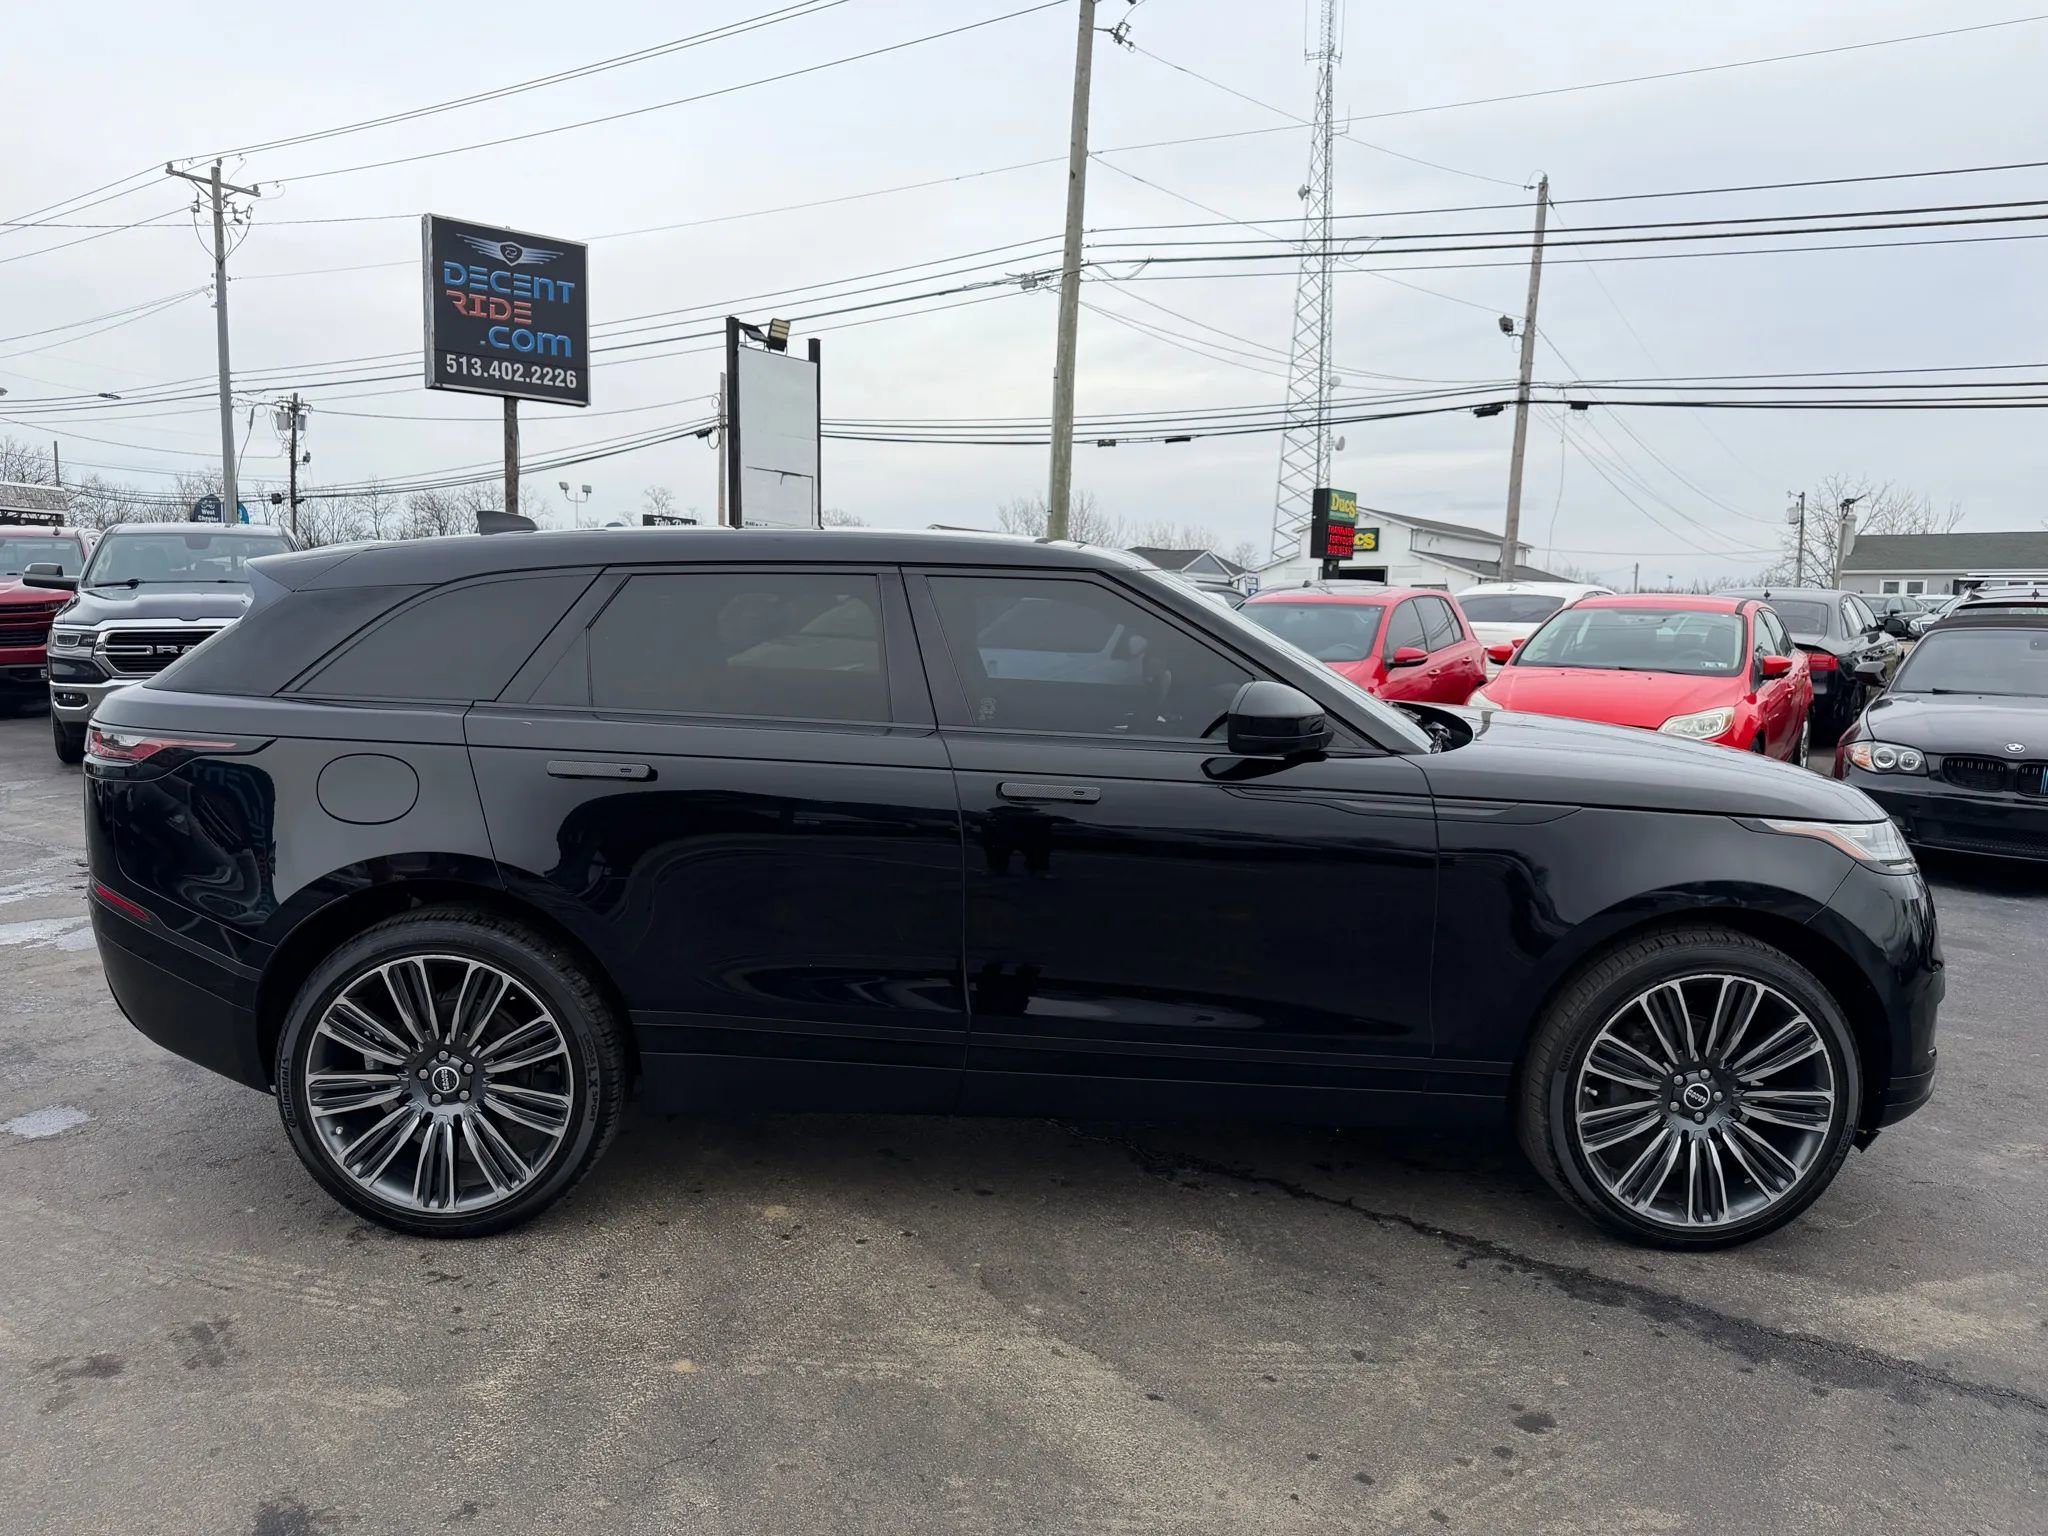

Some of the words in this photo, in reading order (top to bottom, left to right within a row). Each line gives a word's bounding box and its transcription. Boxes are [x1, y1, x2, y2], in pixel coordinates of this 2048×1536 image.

[443, 261, 575, 304] DECENT
[446, 289, 532, 325] RIDE
[446, 353, 577, 389] 513.402.2226
